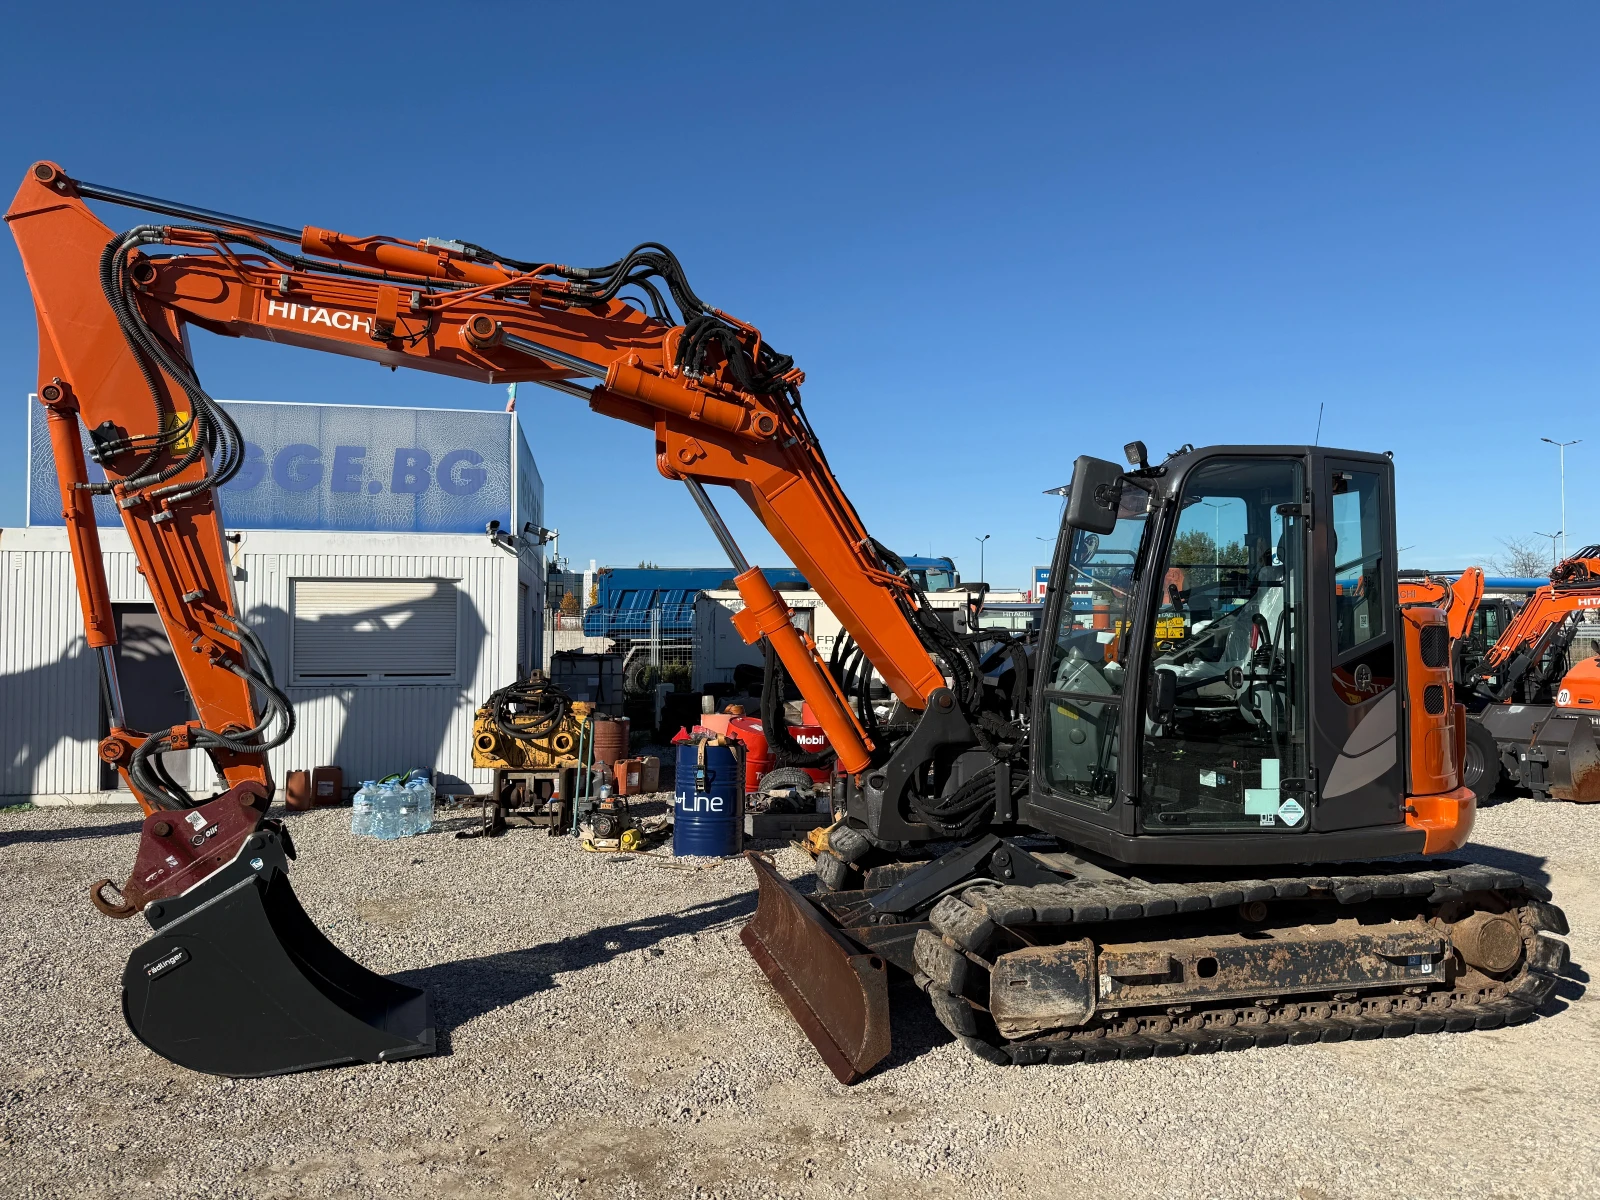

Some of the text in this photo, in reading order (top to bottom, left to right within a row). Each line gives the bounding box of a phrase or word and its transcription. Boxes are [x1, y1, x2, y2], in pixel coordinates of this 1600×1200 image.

[268, 299, 377, 335] HITACH
[1558, 692, 1568, 703] 20
[796, 735, 824, 745] Mobil
